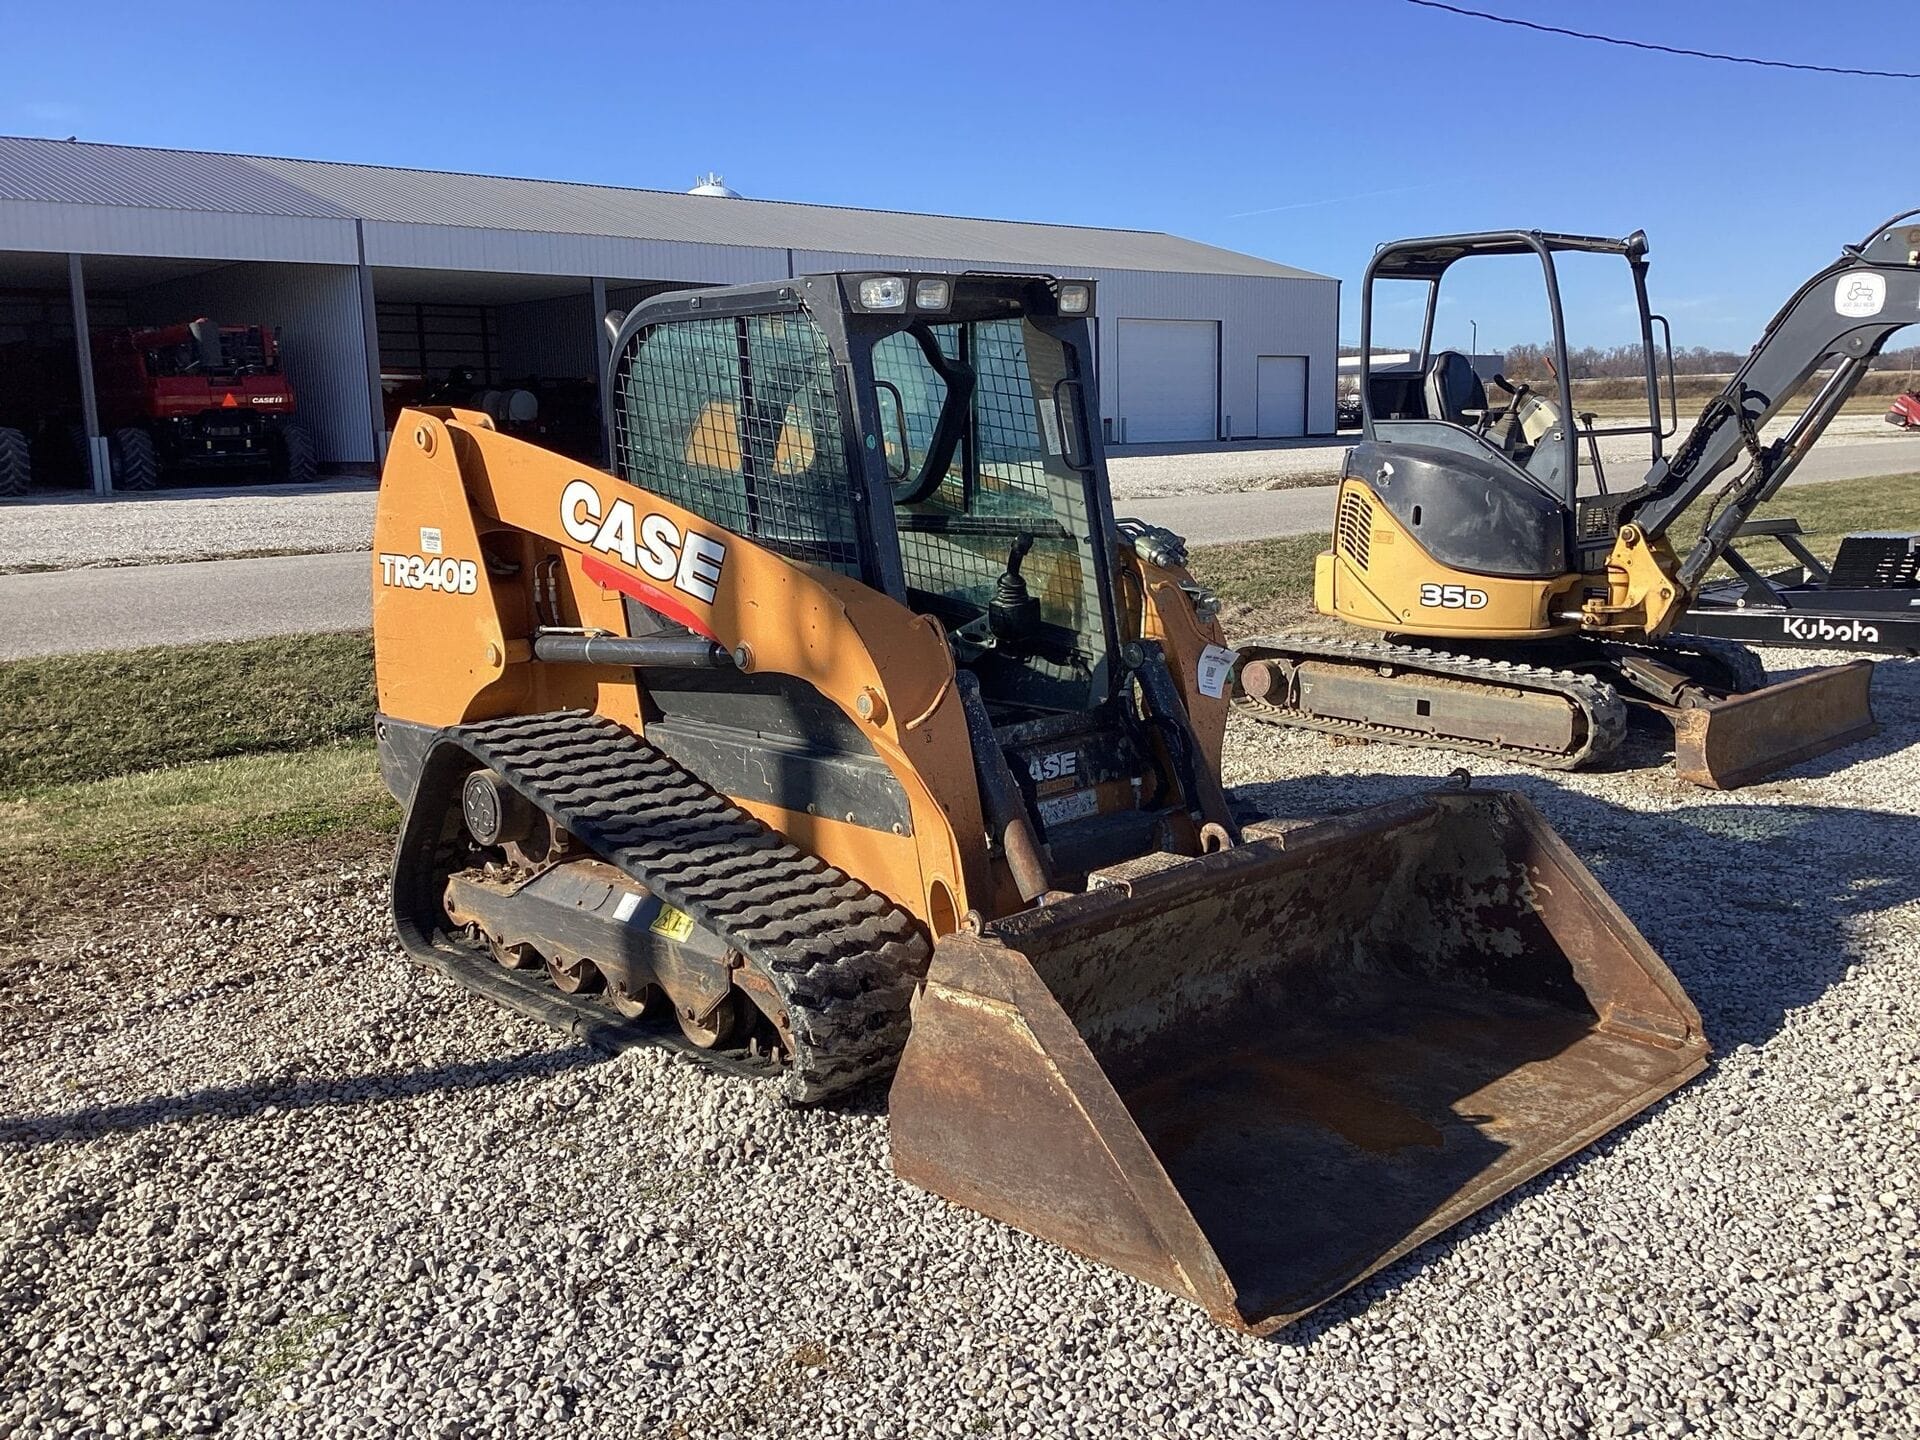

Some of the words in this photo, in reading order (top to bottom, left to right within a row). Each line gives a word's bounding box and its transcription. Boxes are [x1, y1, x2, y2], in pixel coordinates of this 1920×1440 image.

[559, 479, 726, 604] CASE
[379, 552, 478, 595] TR340B
[1420, 583, 1489, 609] 35D
[1783, 617, 1879, 643] Kubota
[1028, 750, 1077, 781] ASE
